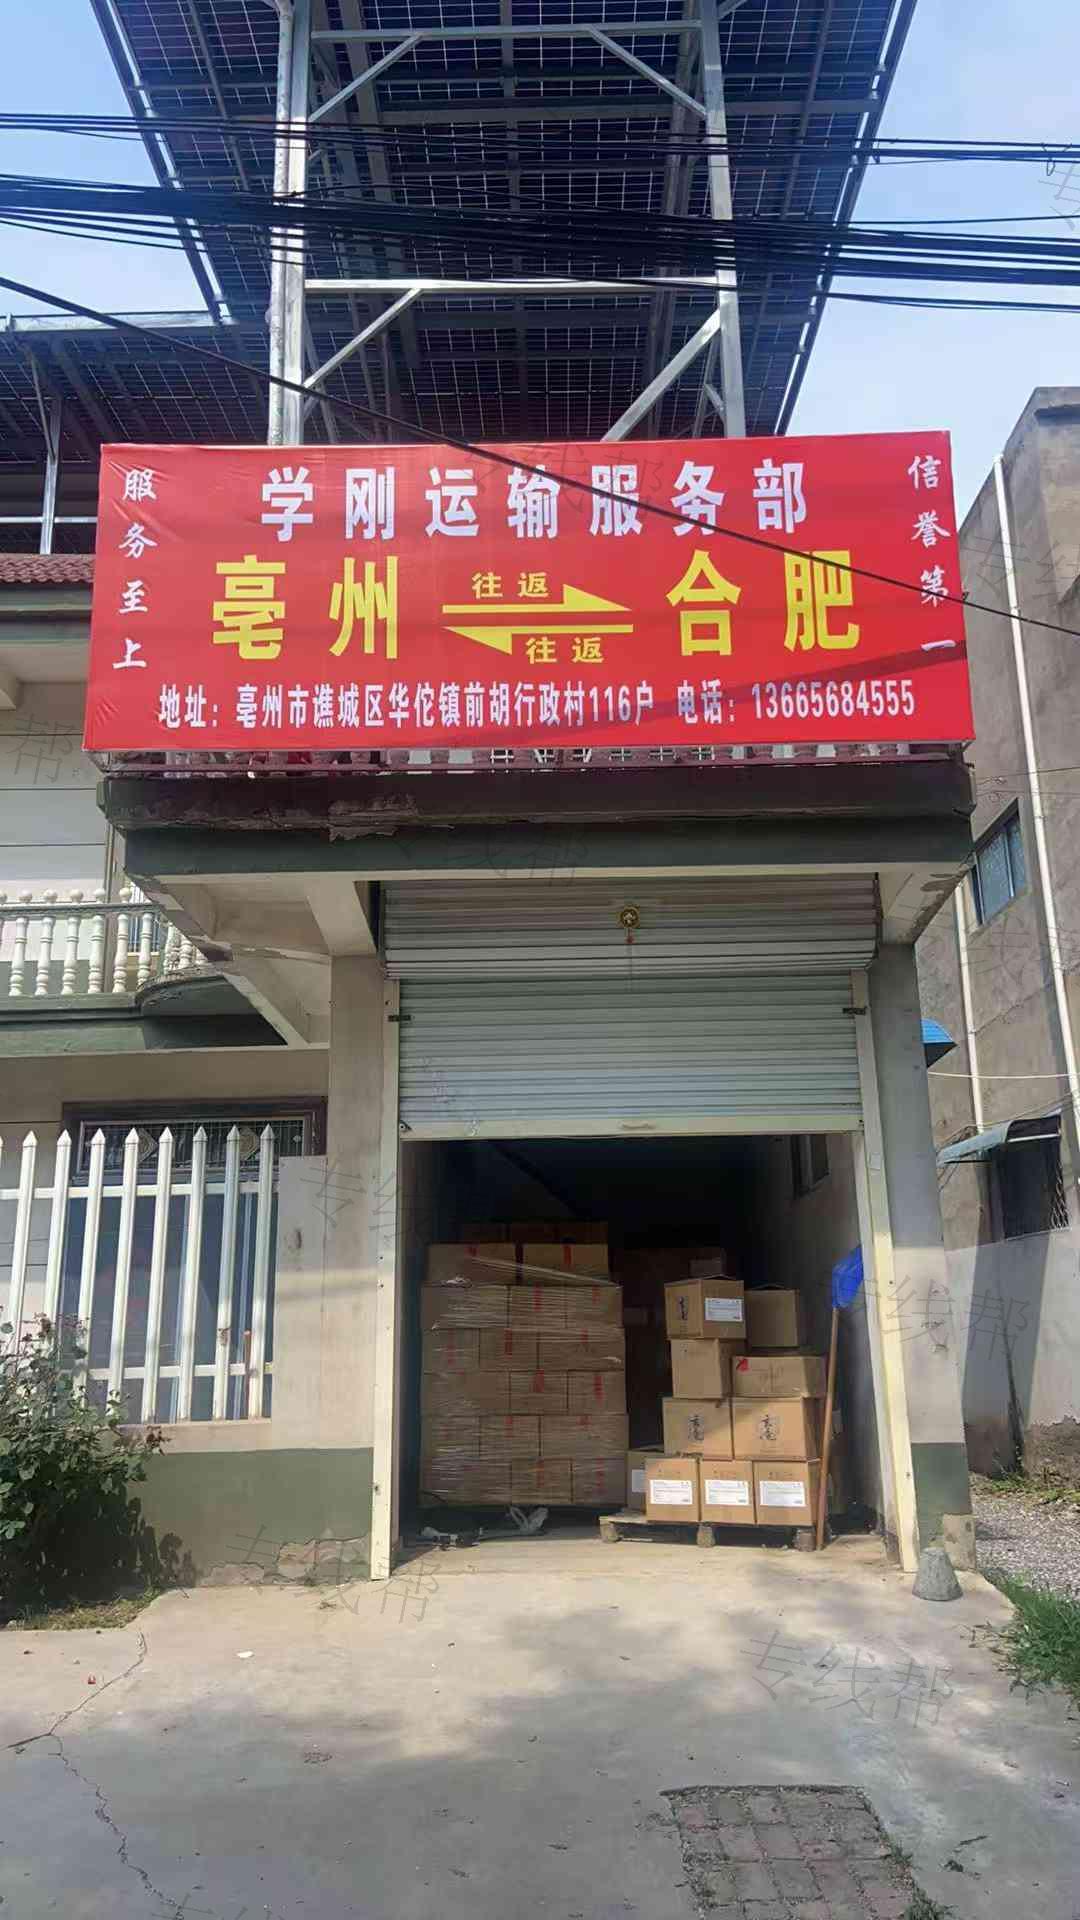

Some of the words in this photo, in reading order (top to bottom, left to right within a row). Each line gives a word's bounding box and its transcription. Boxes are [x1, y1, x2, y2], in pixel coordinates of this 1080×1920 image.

[261, 459, 807, 542] 学刚运输服务部
[112, 467, 158, 670] 服务至上
[471, 571, 549, 600] 往返
[907, 456, 956, 652] 信誉第一
[212, 554, 399, 660] 亳州
[666, 549, 860, 657] 合肥
[525, 636, 604, 665] 往返
